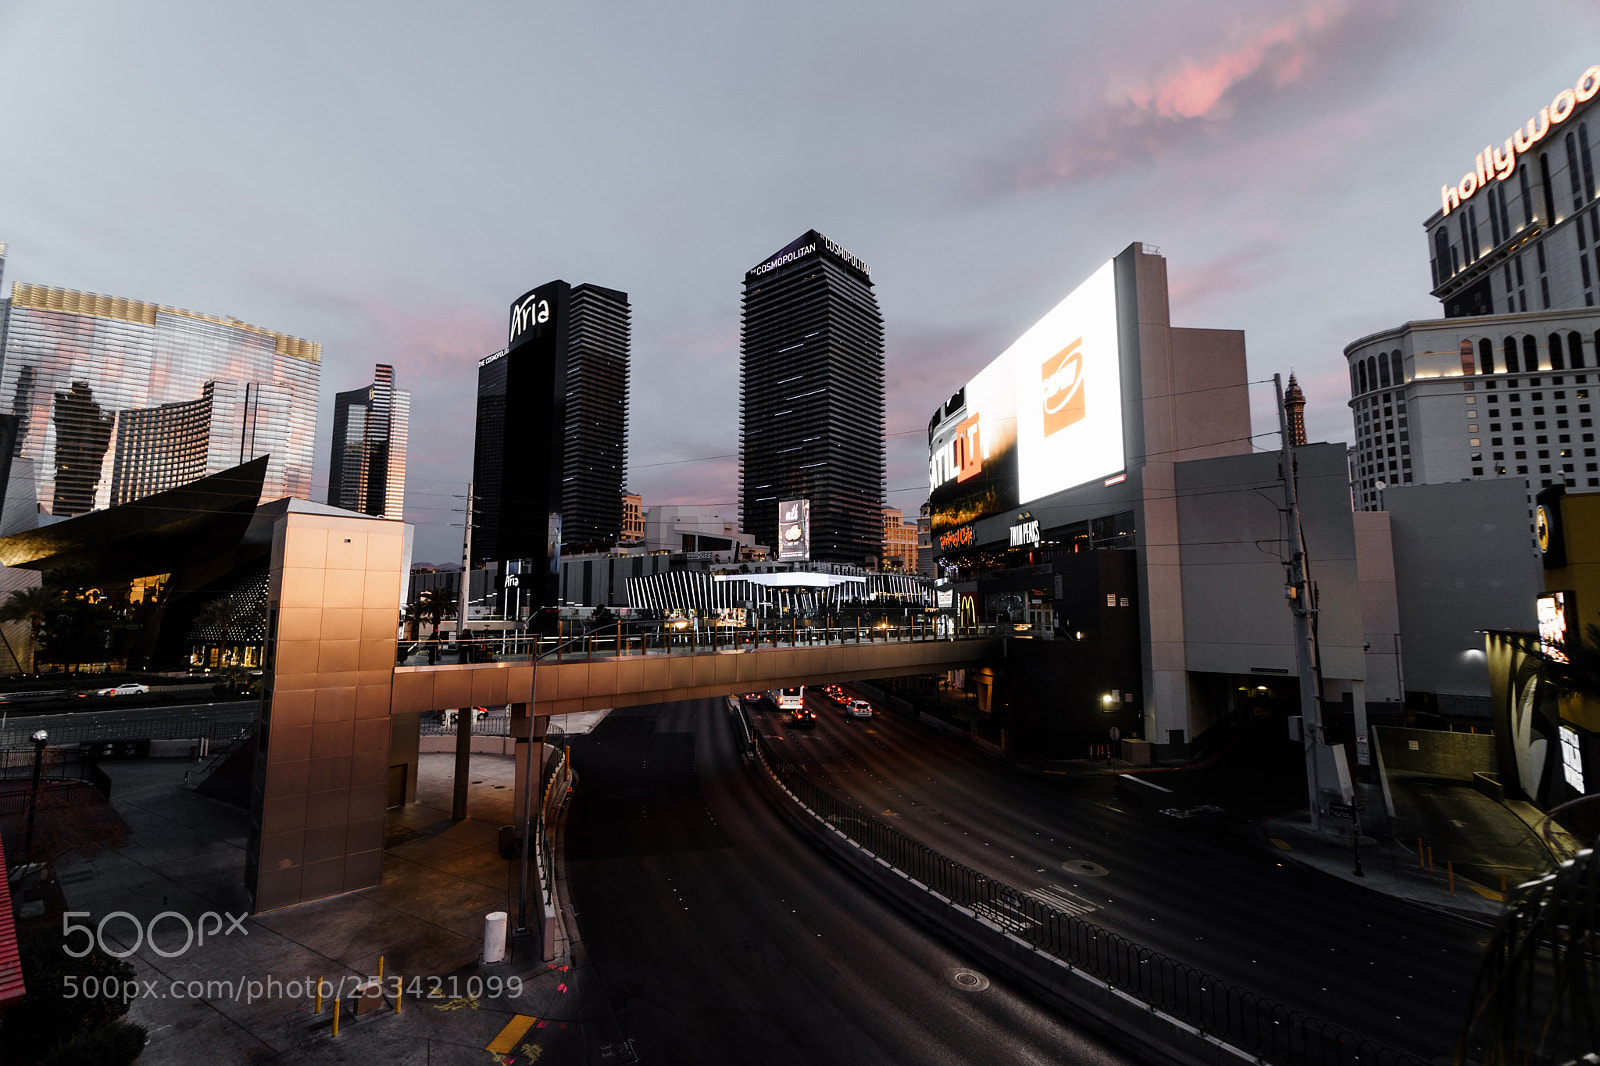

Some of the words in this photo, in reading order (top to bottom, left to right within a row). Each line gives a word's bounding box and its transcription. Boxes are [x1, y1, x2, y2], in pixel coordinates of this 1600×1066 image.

[756, 242, 816, 276] COSMOPOLITAN
[825, 236, 872, 275] COSMOPOLITAN
[510, 294, 549, 342] Aria
[1010, 524, 1022, 547] TWIN
[1023, 520, 1040, 545] PEAKS
